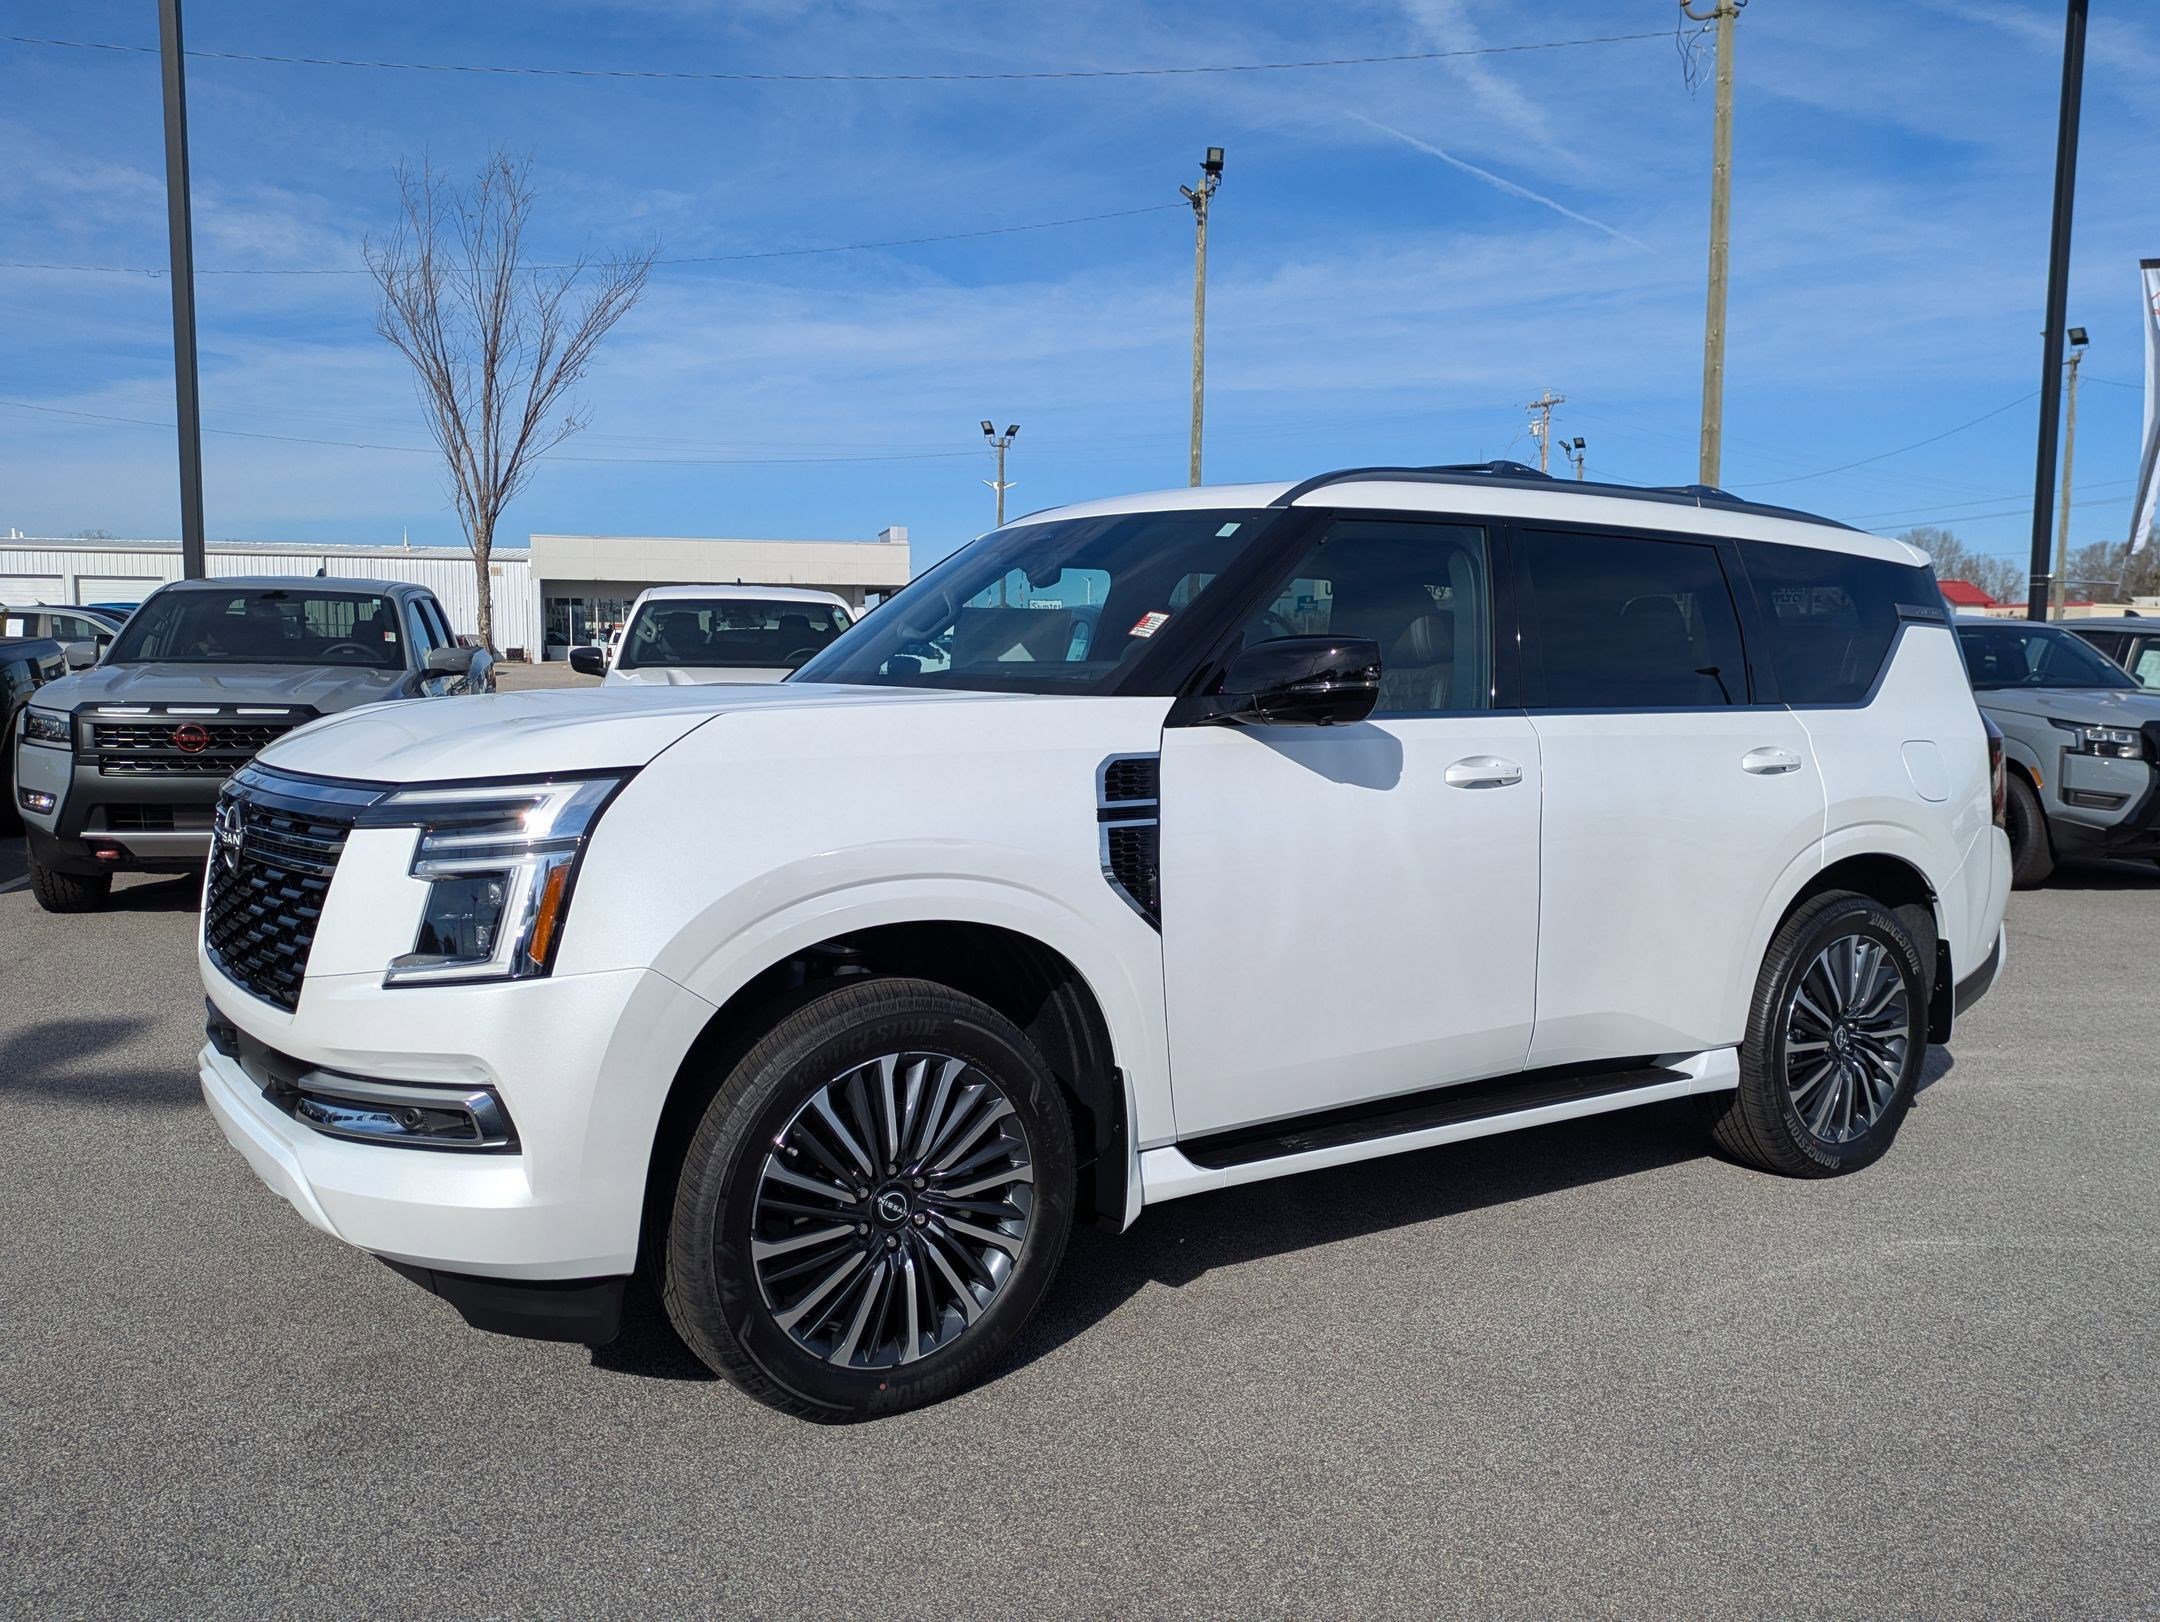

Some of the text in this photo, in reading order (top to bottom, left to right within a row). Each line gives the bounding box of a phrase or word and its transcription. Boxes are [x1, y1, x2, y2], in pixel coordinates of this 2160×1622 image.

[222, 831, 241, 846] SAN
[1868, 911, 1921, 976] BRIDGESTONE
[1782, 1110, 1842, 1171] BRIDGESTONE
[877, 1196, 909, 1218] NISSAN
